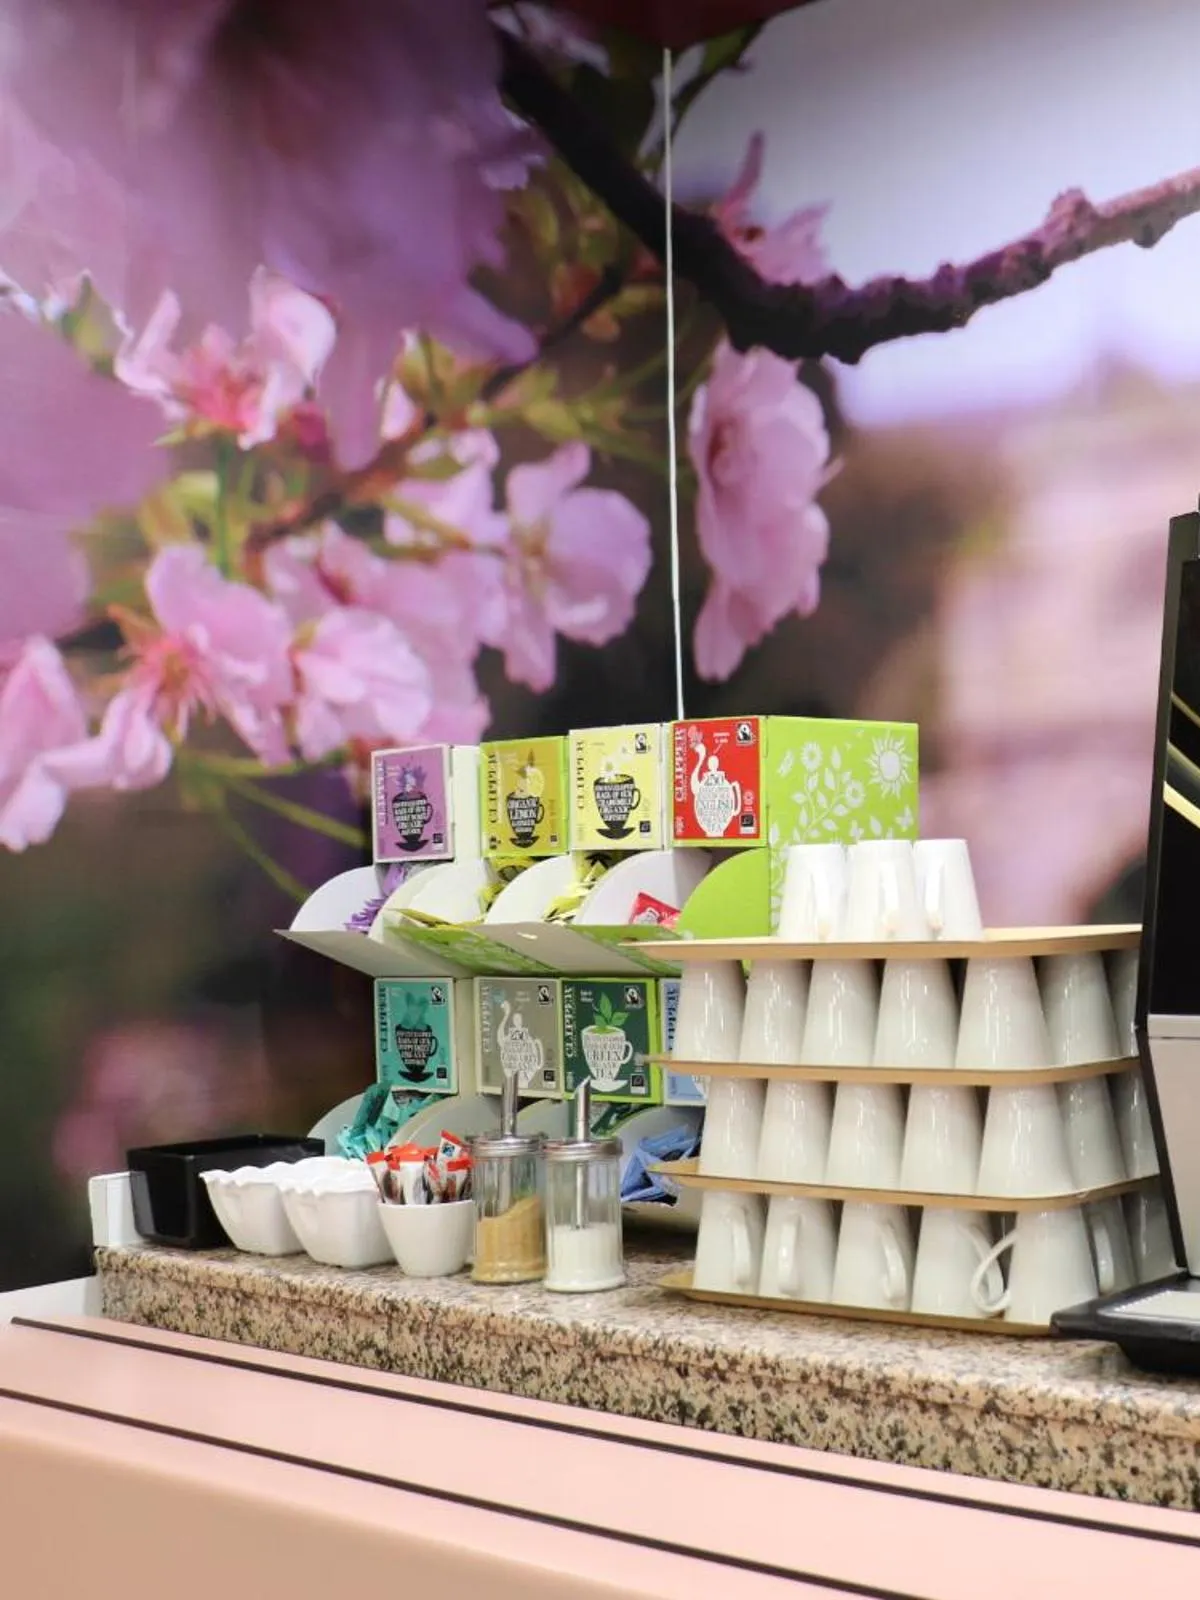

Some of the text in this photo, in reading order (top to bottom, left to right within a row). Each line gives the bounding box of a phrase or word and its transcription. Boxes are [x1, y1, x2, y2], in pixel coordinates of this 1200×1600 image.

[487, 754, 498, 824] CLIPPER
[576, 740, 585, 810] CLIPPER
[674, 726, 685, 802] CLIPPER
[510, 808, 538, 820] LEMON
[378, 986, 388, 1053] CLIPPER
[481, 986, 492, 1053] CLIPPER
[564, 986, 575, 1059] CLIPPER
[586, 1050, 623, 1061] GREEN
[595, 1068, 614, 1079] TEA
